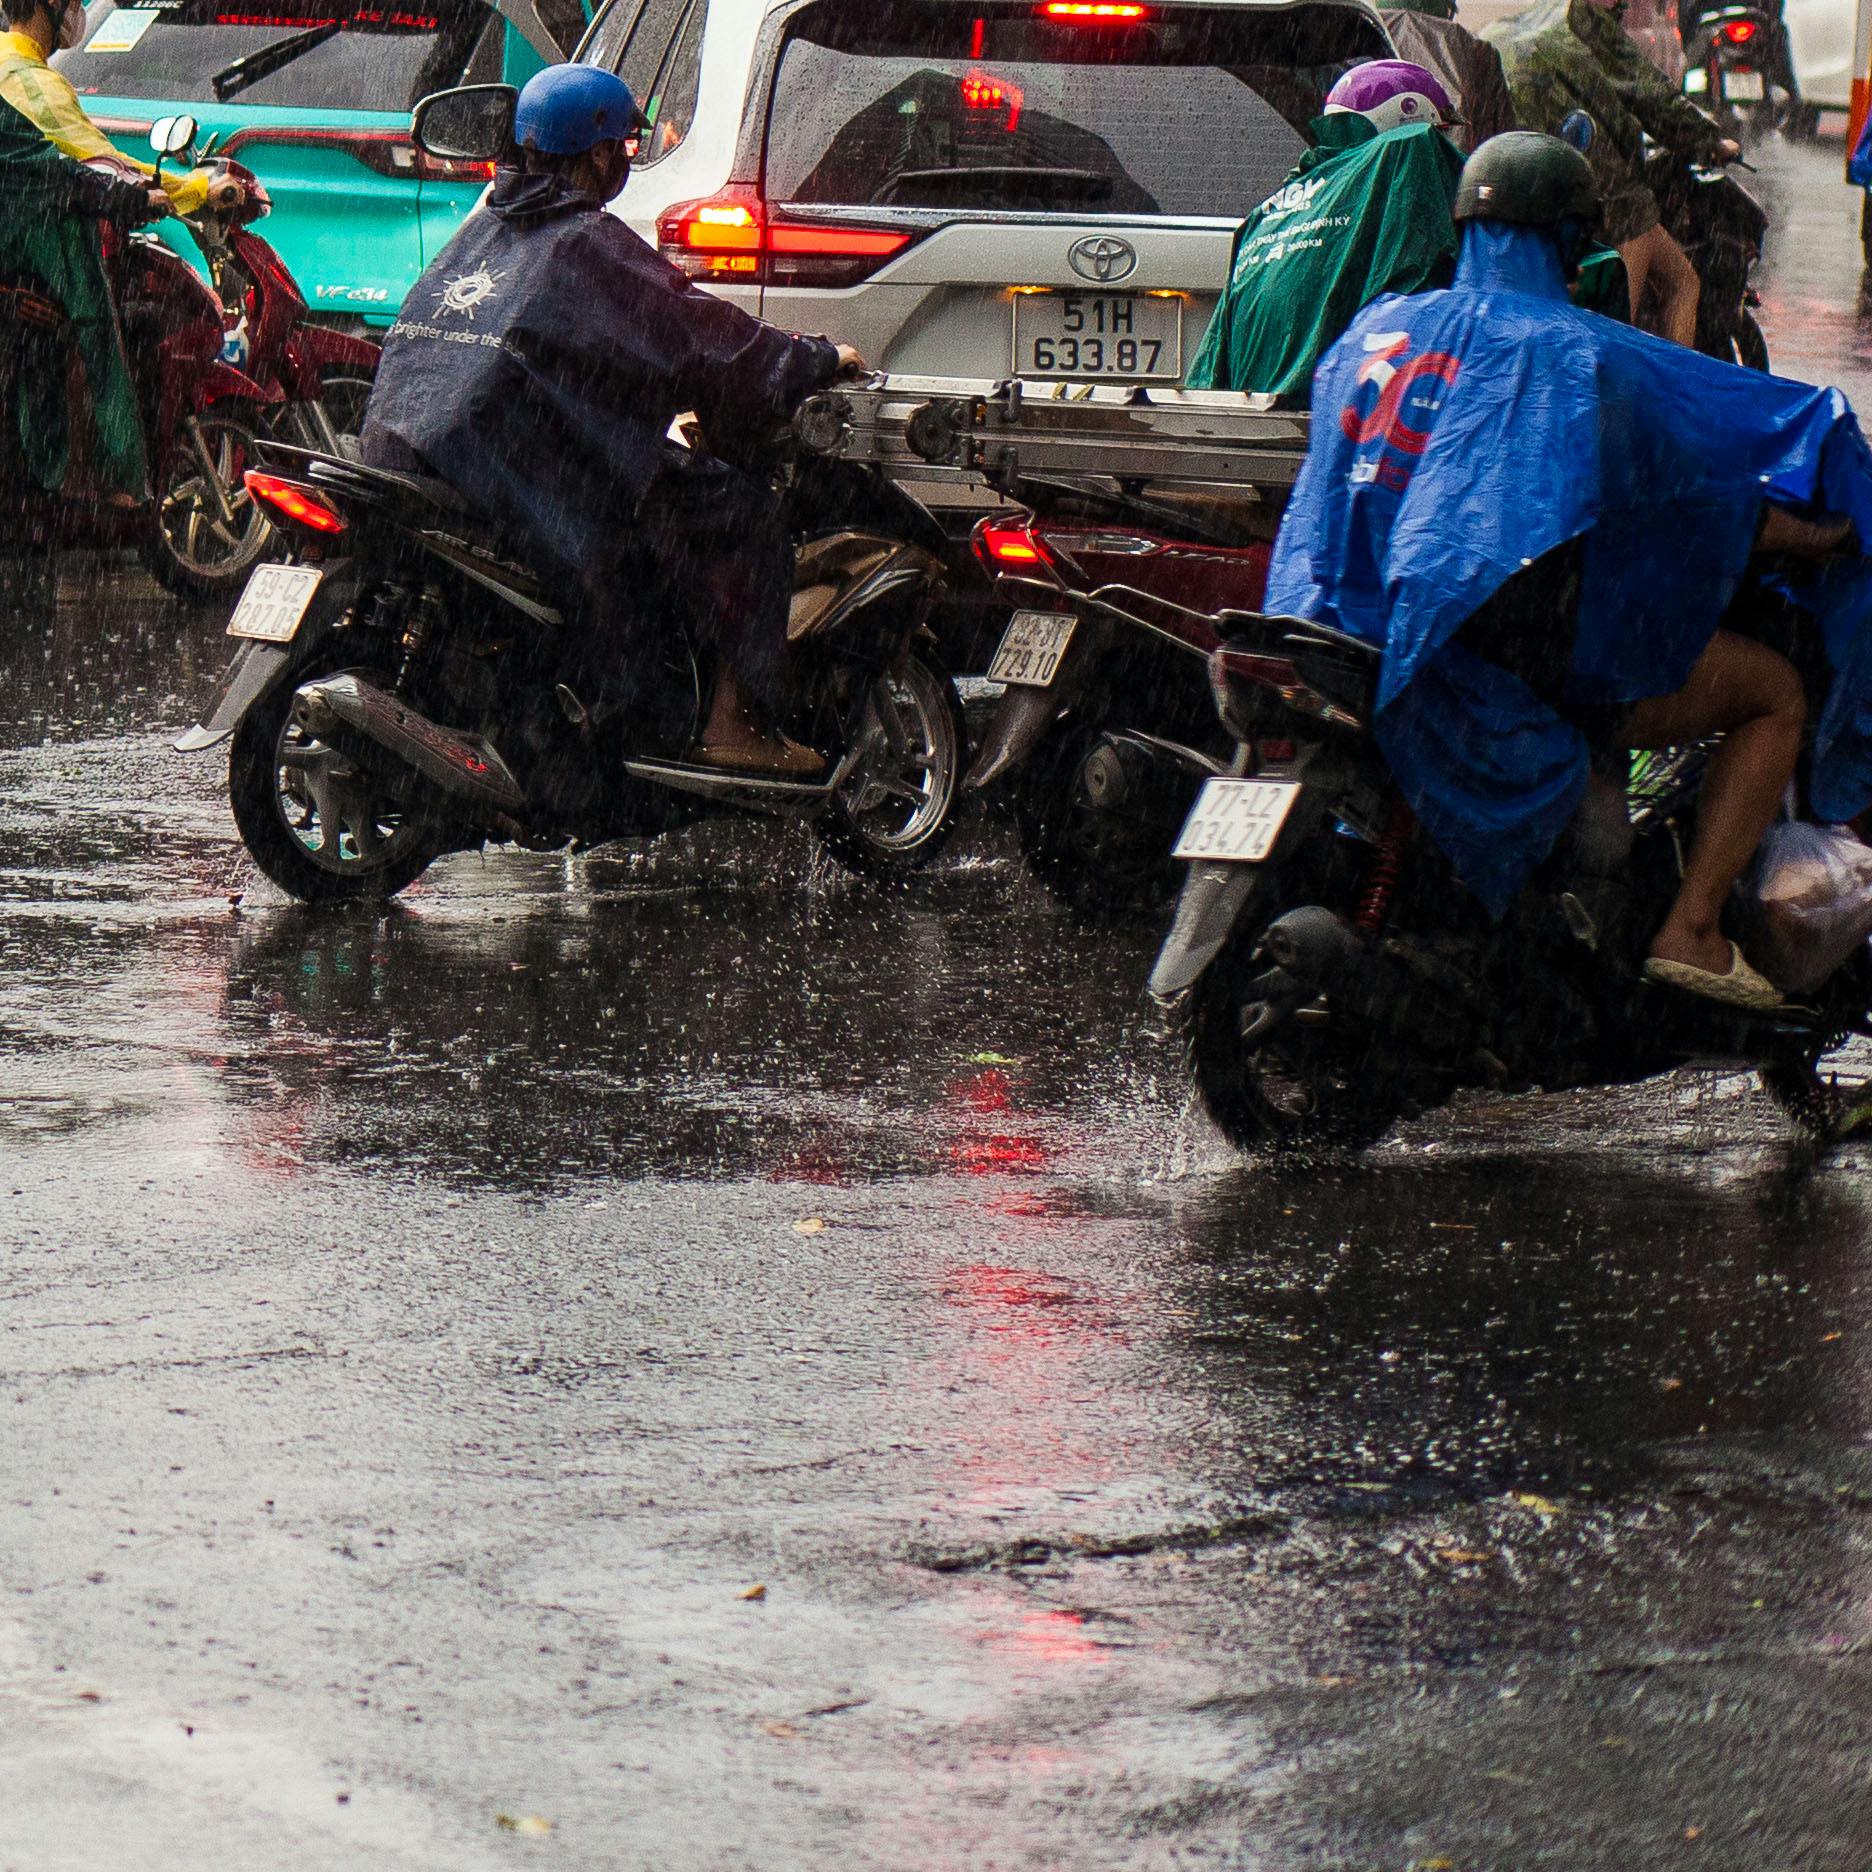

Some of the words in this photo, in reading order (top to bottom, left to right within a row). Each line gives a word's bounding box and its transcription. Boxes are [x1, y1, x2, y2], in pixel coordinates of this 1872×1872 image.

[394, 319, 443, 340] brighter
[443, 328, 481, 345] under
[480, 331, 503, 349] the
[1062, 299, 1133, 334] 51H
[1033, 336, 1163, 373] 633.87
